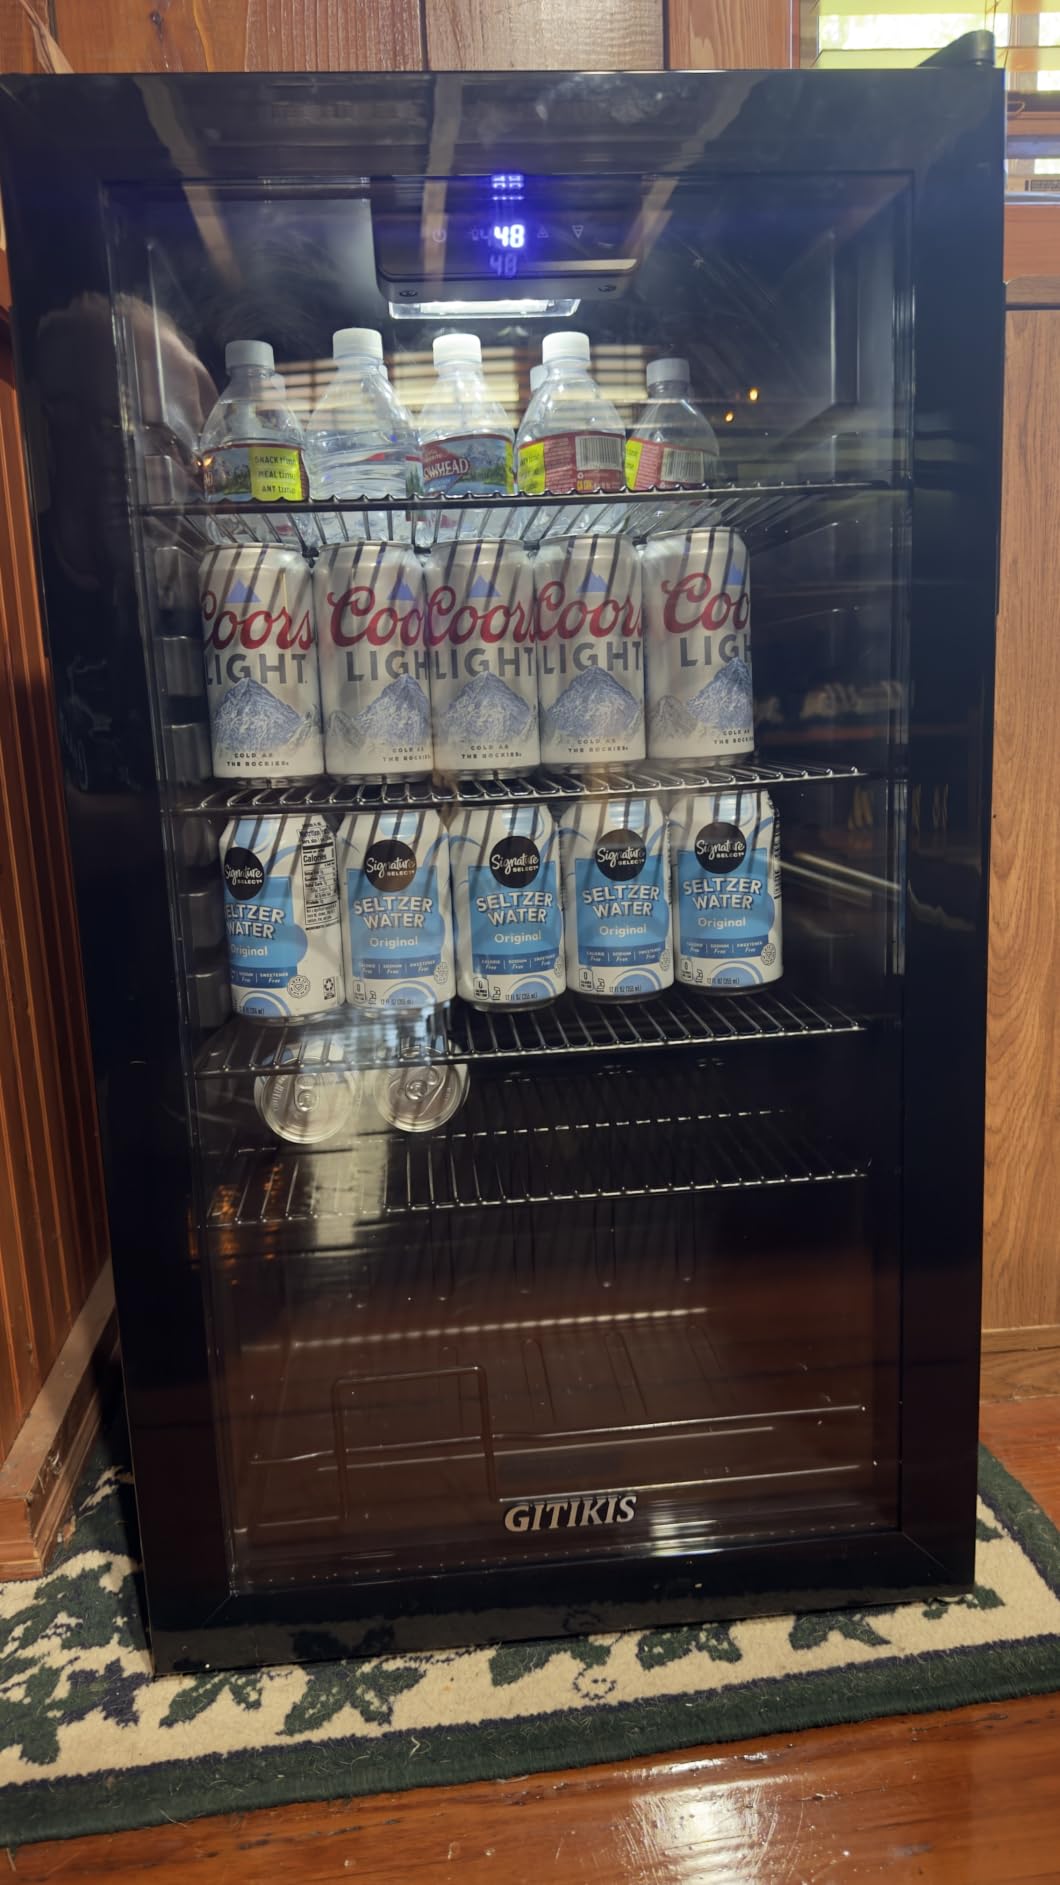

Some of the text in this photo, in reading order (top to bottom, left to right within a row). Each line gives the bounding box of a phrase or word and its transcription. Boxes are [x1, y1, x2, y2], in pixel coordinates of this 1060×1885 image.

[494, 224, 525, 248] 48
[255, 456, 278, 464] SNACK
[424, 458, 469, 480] OWHEAD
[257, 471, 278, 479] MEAL
[661, 572, 750, 633] Coo
[327, 586, 423, 647] Coo
[543, 641, 641, 674] LIGHT
[680, 633, 751, 667] LIG
[346, 650, 428, 681] LIGH
[435, 647, 533, 680] LIGHT
[696, 839, 745, 860] Signatre
[491, 853, 539, 875] Signature
[225, 864, 263, 885] Signature
[582, 885, 660, 903] SELTZER
[683, 878, 762, 895] SELTZER
[353, 896, 433, 914] SELTZER
[476, 892, 553, 912] SELTZER
[592, 901, 652, 918] WATER
[692, 895, 753, 910] WATER
[224, 904, 285, 923] ELTZER
[363, 912, 425, 929] WATER
[488, 908, 547, 926] WATER
[227, 921, 274, 939] WATER
[600, 924, 647, 937] Original
[698, 917, 746, 929] Original
[369, 936, 418, 949] Original
[494, 931, 541, 944] Original
[231, 944, 268, 957] Original
[504, 1495, 637, 1533] GITIKIS
